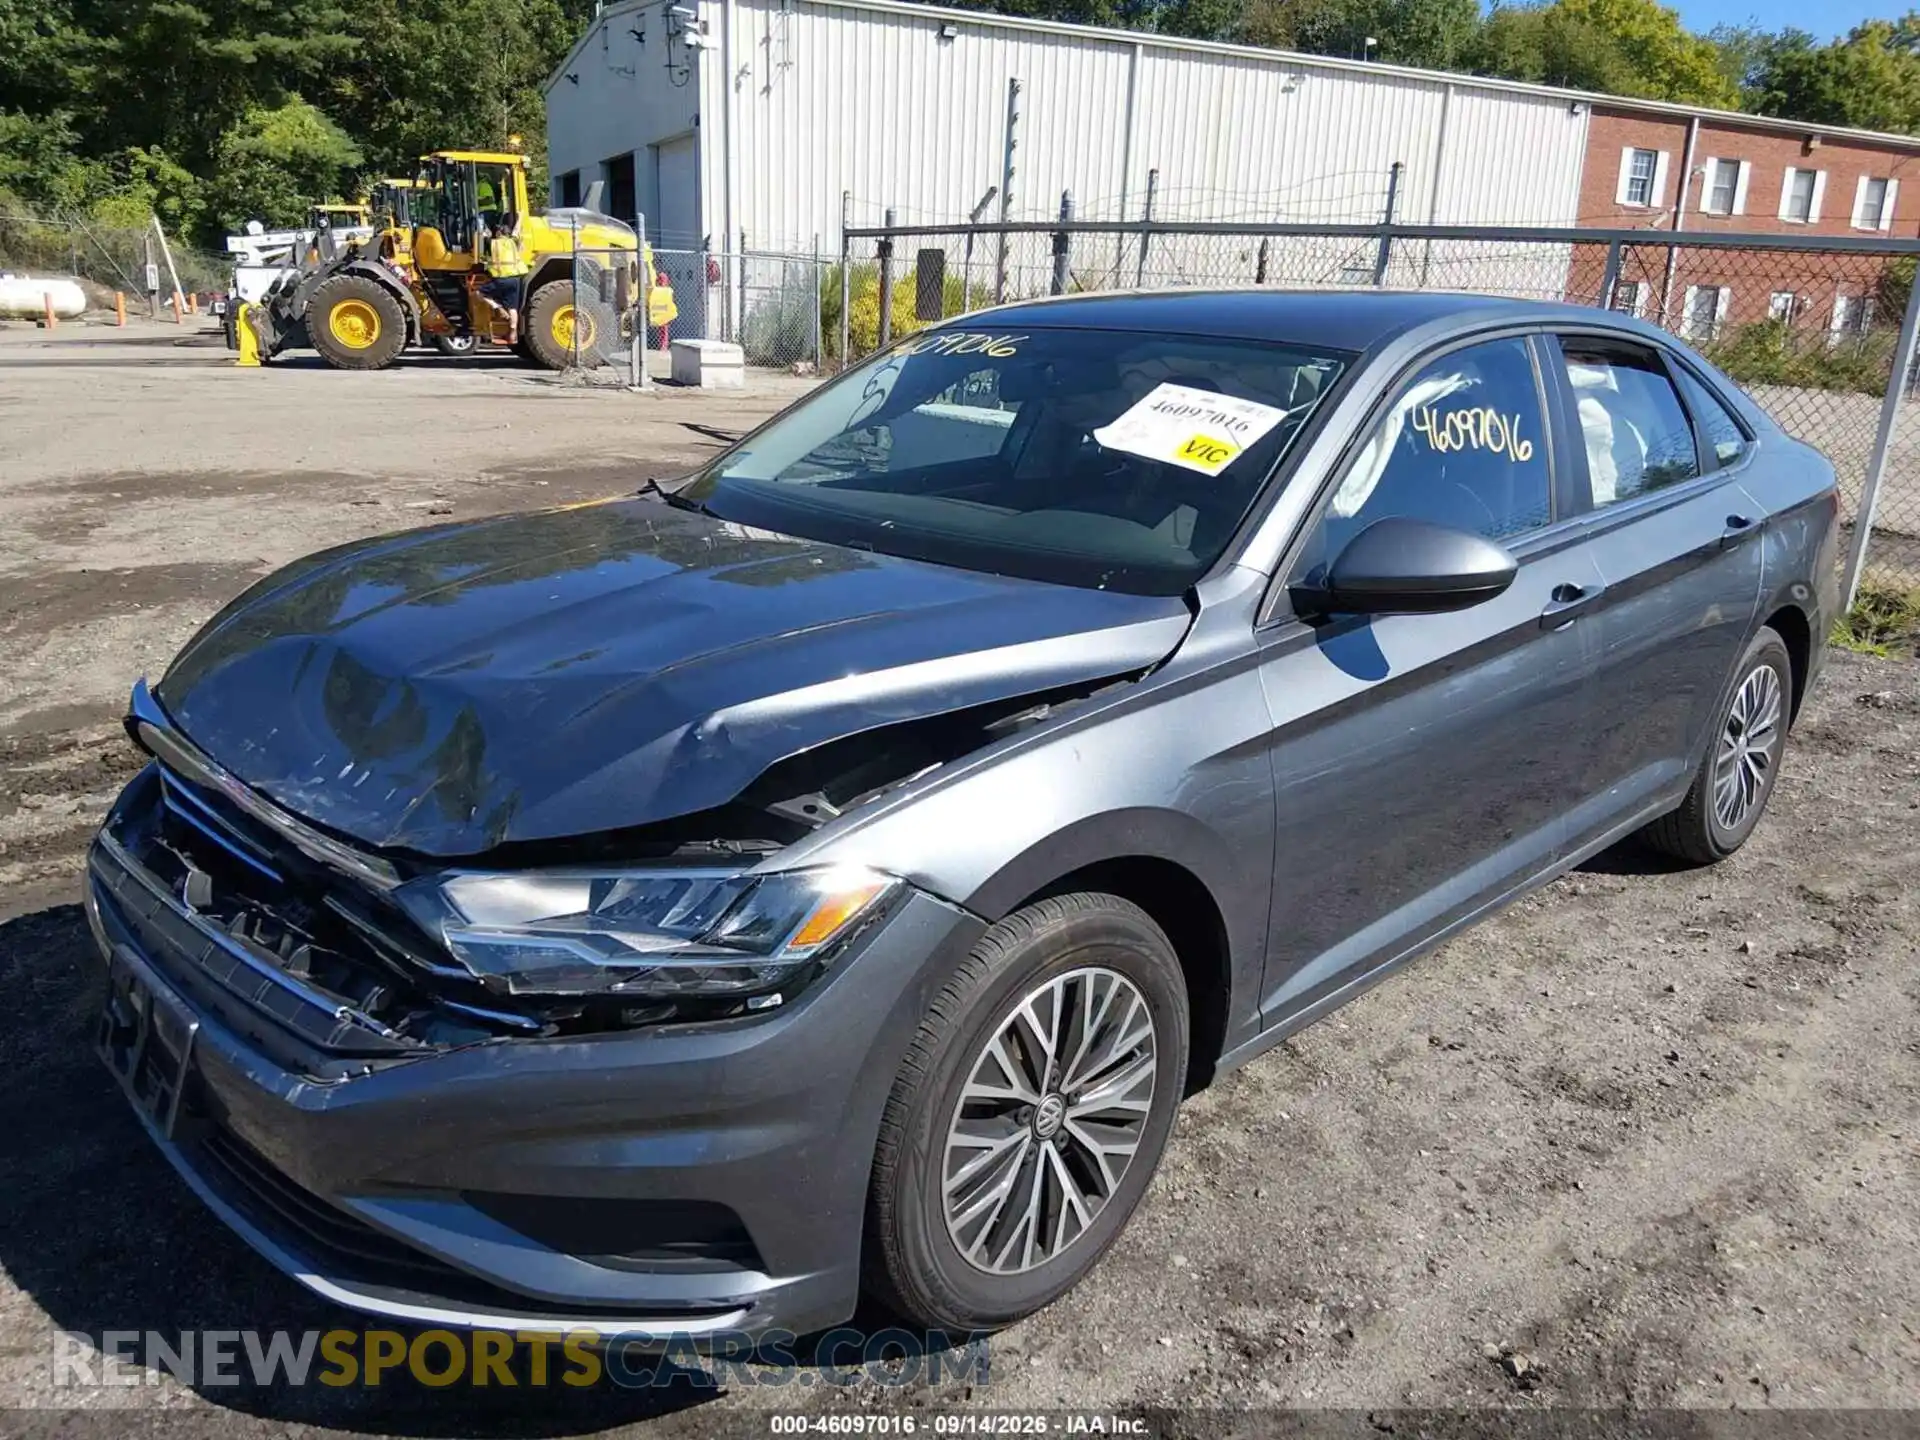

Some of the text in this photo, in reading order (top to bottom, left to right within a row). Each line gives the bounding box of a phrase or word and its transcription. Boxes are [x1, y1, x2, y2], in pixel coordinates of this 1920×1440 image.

[1150, 399, 1252, 433] 46097016
[1412, 403, 1532, 463] 46097016
[1185, 439, 1229, 463] VIC
